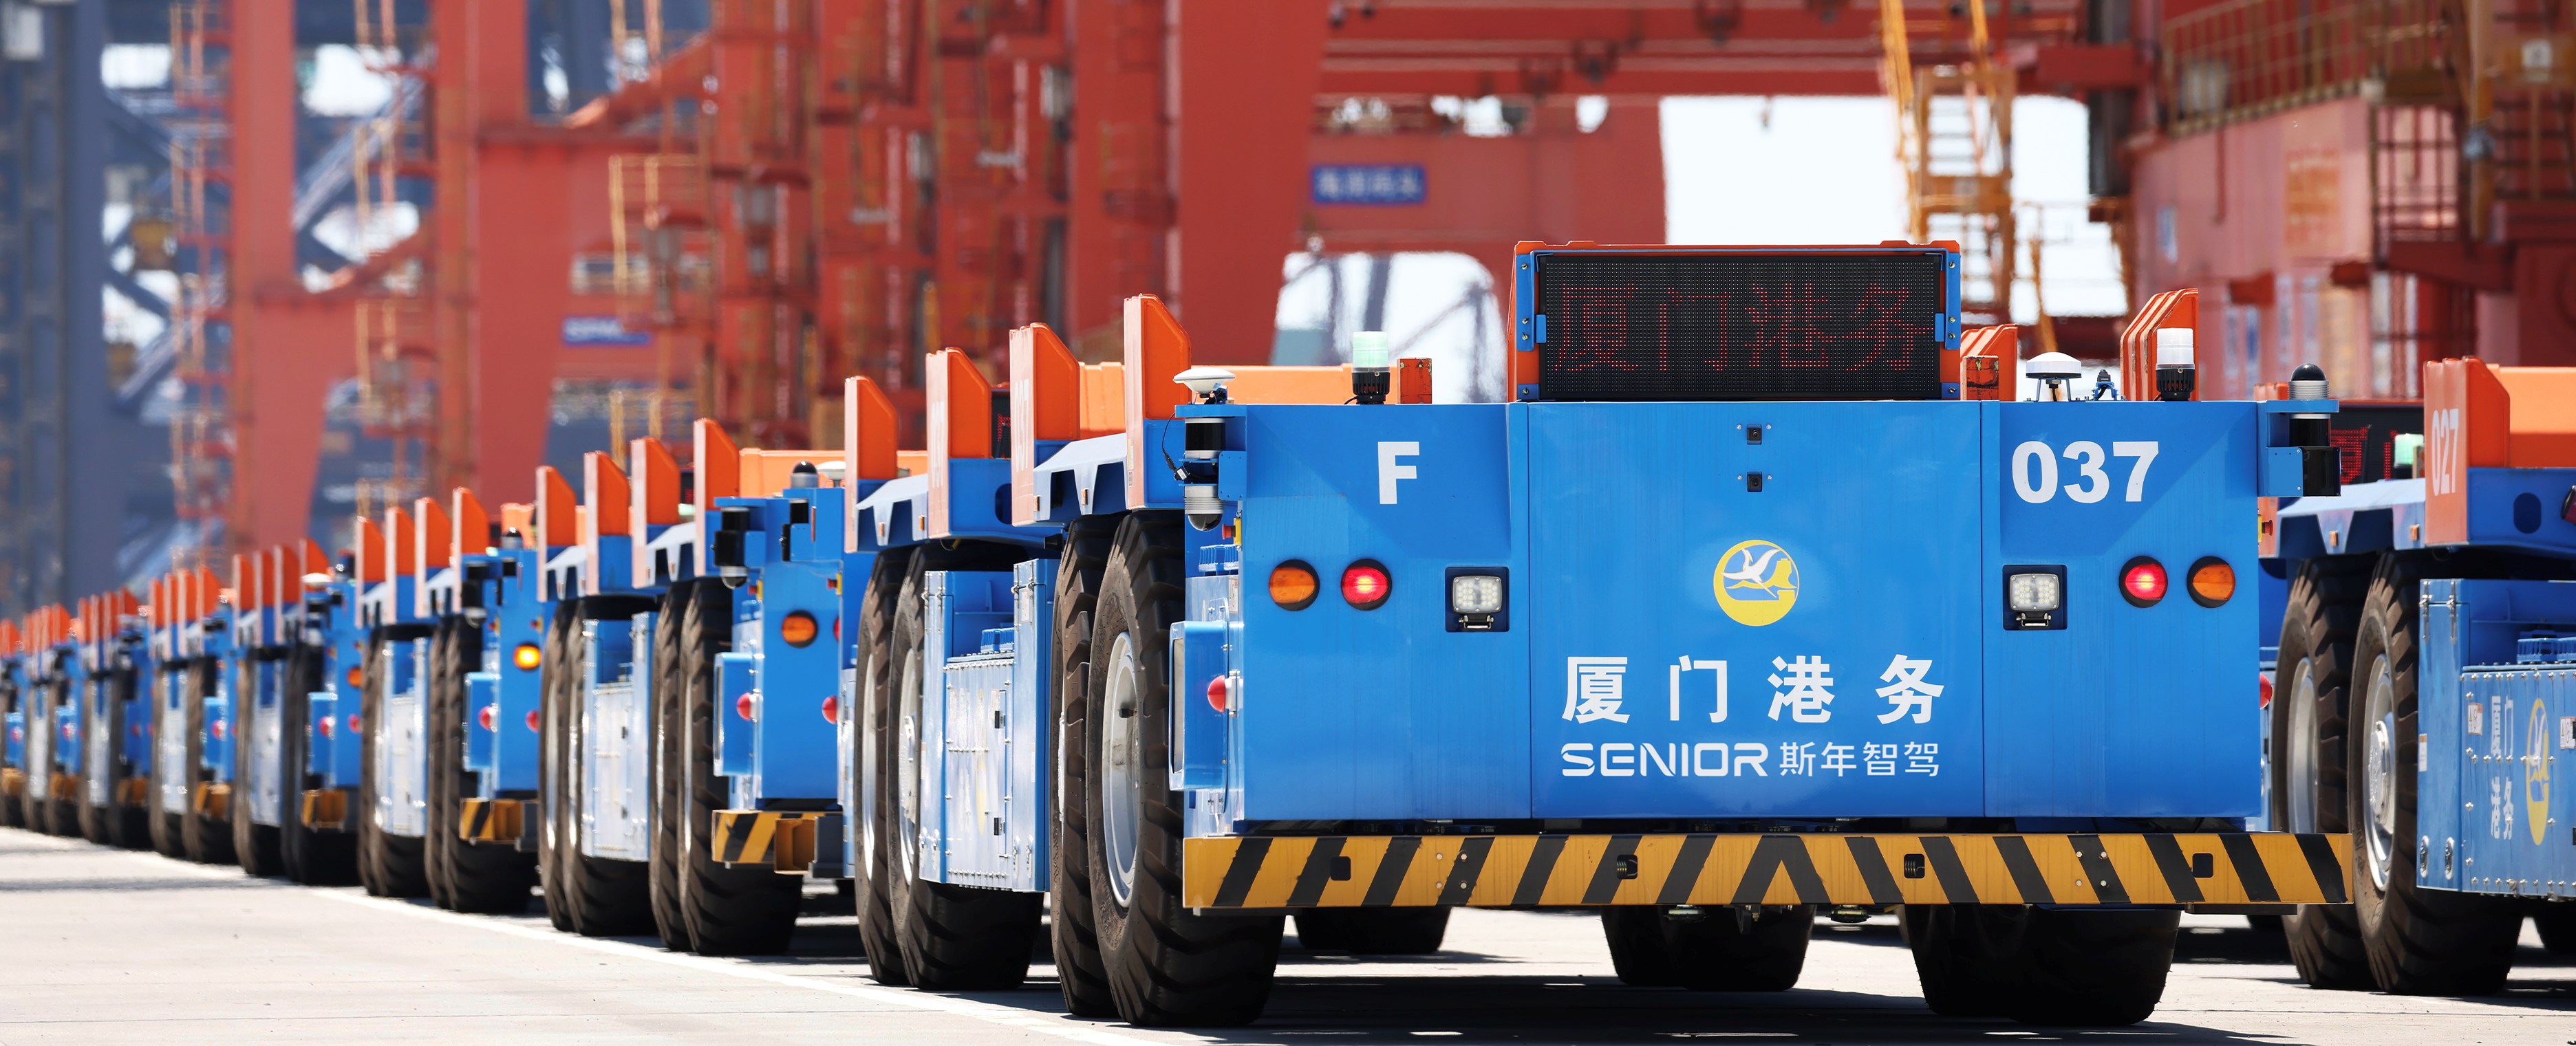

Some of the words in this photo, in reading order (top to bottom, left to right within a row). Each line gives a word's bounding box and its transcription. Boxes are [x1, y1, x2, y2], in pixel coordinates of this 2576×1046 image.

[1555, 283, 1936, 371] 厦门港务
[1377, 442, 1419, 505] F
[2012, 441, 2159, 503] 037
[2432, 408, 2459, 497] 027
[1561, 654, 1944, 724] 厦门港务
[1561, 743, 1769, 777] SENIOR
[1779, 741, 1940, 777] 斯年智驾
